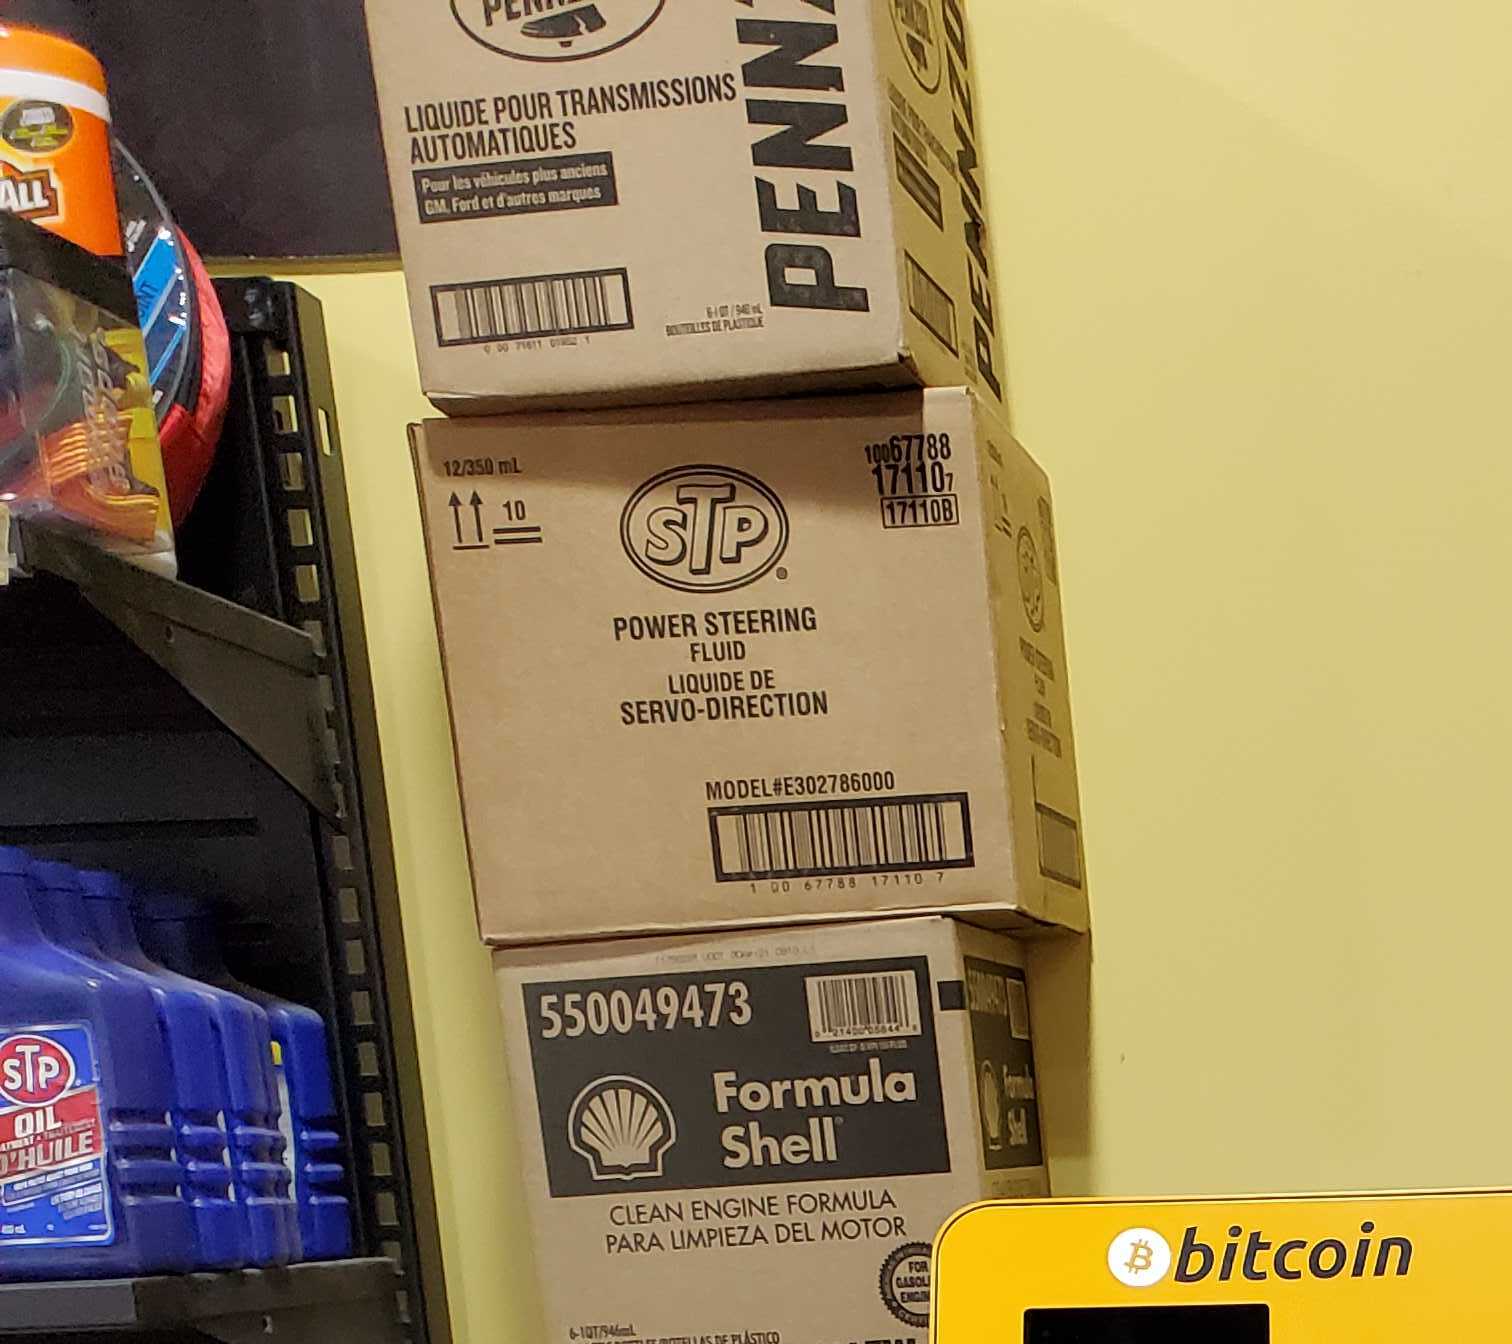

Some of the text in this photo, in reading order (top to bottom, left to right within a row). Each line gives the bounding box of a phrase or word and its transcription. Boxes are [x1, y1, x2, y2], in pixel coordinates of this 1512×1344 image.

[404, 73, 736, 132] LIQUIDE POUR TRANSMISSIONS
[411, 121, 577, 165] AUTOMATIQUES
[644, 483, 769, 575] STP
[884, 501, 954, 524] 17110B
[613, 607, 817, 640] POWER STEERING
[690, 641, 746, 662] FLUID
[668, 669, 775, 694] LIQUIDE DE
[620, 692, 828, 724] SERVO-DIRECTION
[706, 771, 895, 800] MODEL#E302786000
[540, 981, 752, 1038] 550049473
[4, 1045, 60, 1093] STP
[713, 1057, 917, 1113] Formula
[14, 1106, 62, 1138] OIL
[720, 1116, 837, 1168] Shell
[610, 1190, 896, 1225] CLEAN ENGINE FORMULA
[606, 1216, 906, 1254] PARA LIMPIEZA DEL MOTOR
[1174, 1222, 1413, 1282] bitcoin
